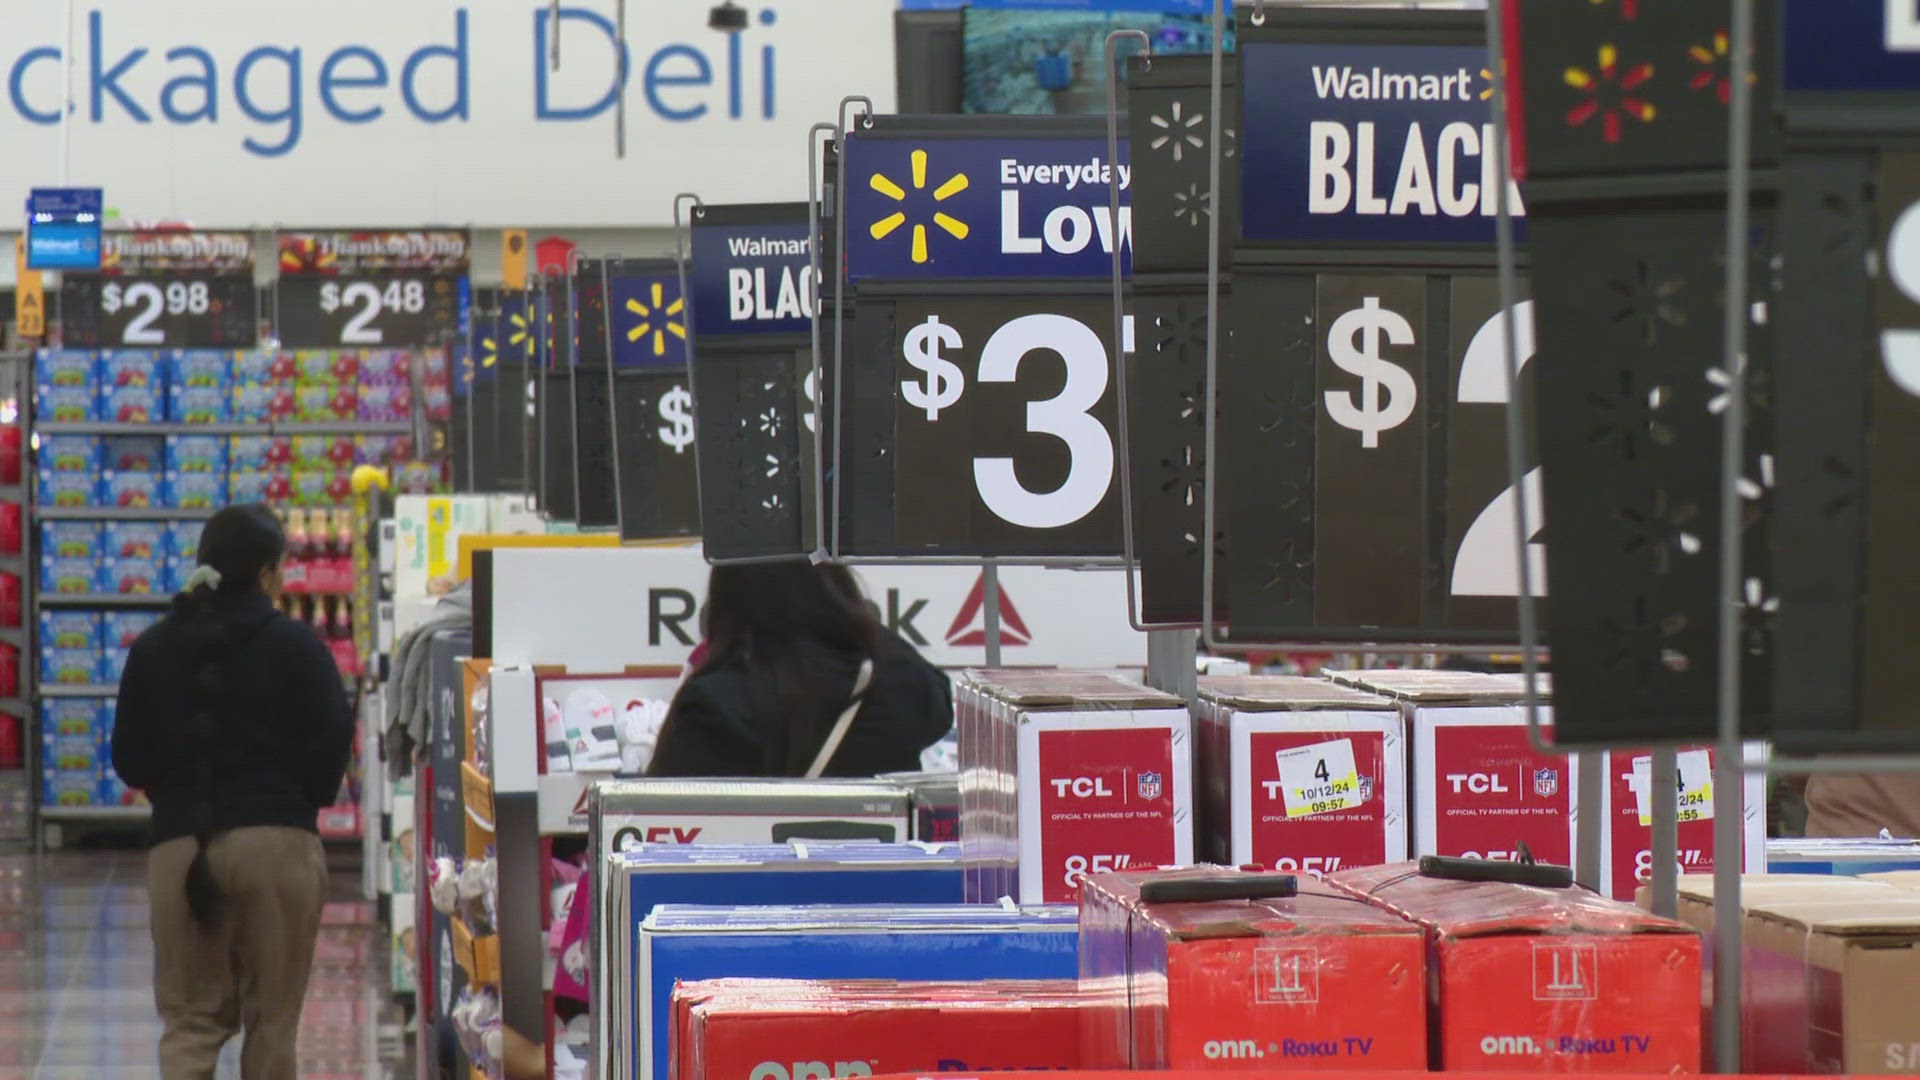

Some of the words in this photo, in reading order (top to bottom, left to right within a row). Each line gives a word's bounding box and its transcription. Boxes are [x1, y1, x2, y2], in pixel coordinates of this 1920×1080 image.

[7, 9, 469, 157] ckaged
[534, 8, 776, 120] Deli
[1311, 65, 1472, 101] Walmart
[1000, 157, 1131, 191] Everyday
[901, 313, 1135, 529] $3
[1314, 758, 1330, 782] 4
[1050, 776, 1113, 798] TCL
[1300, 781, 1350, 801] 10/12/24
[1446, 773, 1509, 794] TCL
[1537, 780, 1556, 793] NFL
[1311, 797, 1345, 813] 09:57
[1203, 1039, 1265, 1059] onn.
[1282, 1038, 1338, 1057] Roku
[1343, 1036, 1373, 1056] TV
[1480, 1035, 1542, 1055] onn.
[1559, 1035, 1616, 1054] Roku
[1620, 1034, 1651, 1053] TV
